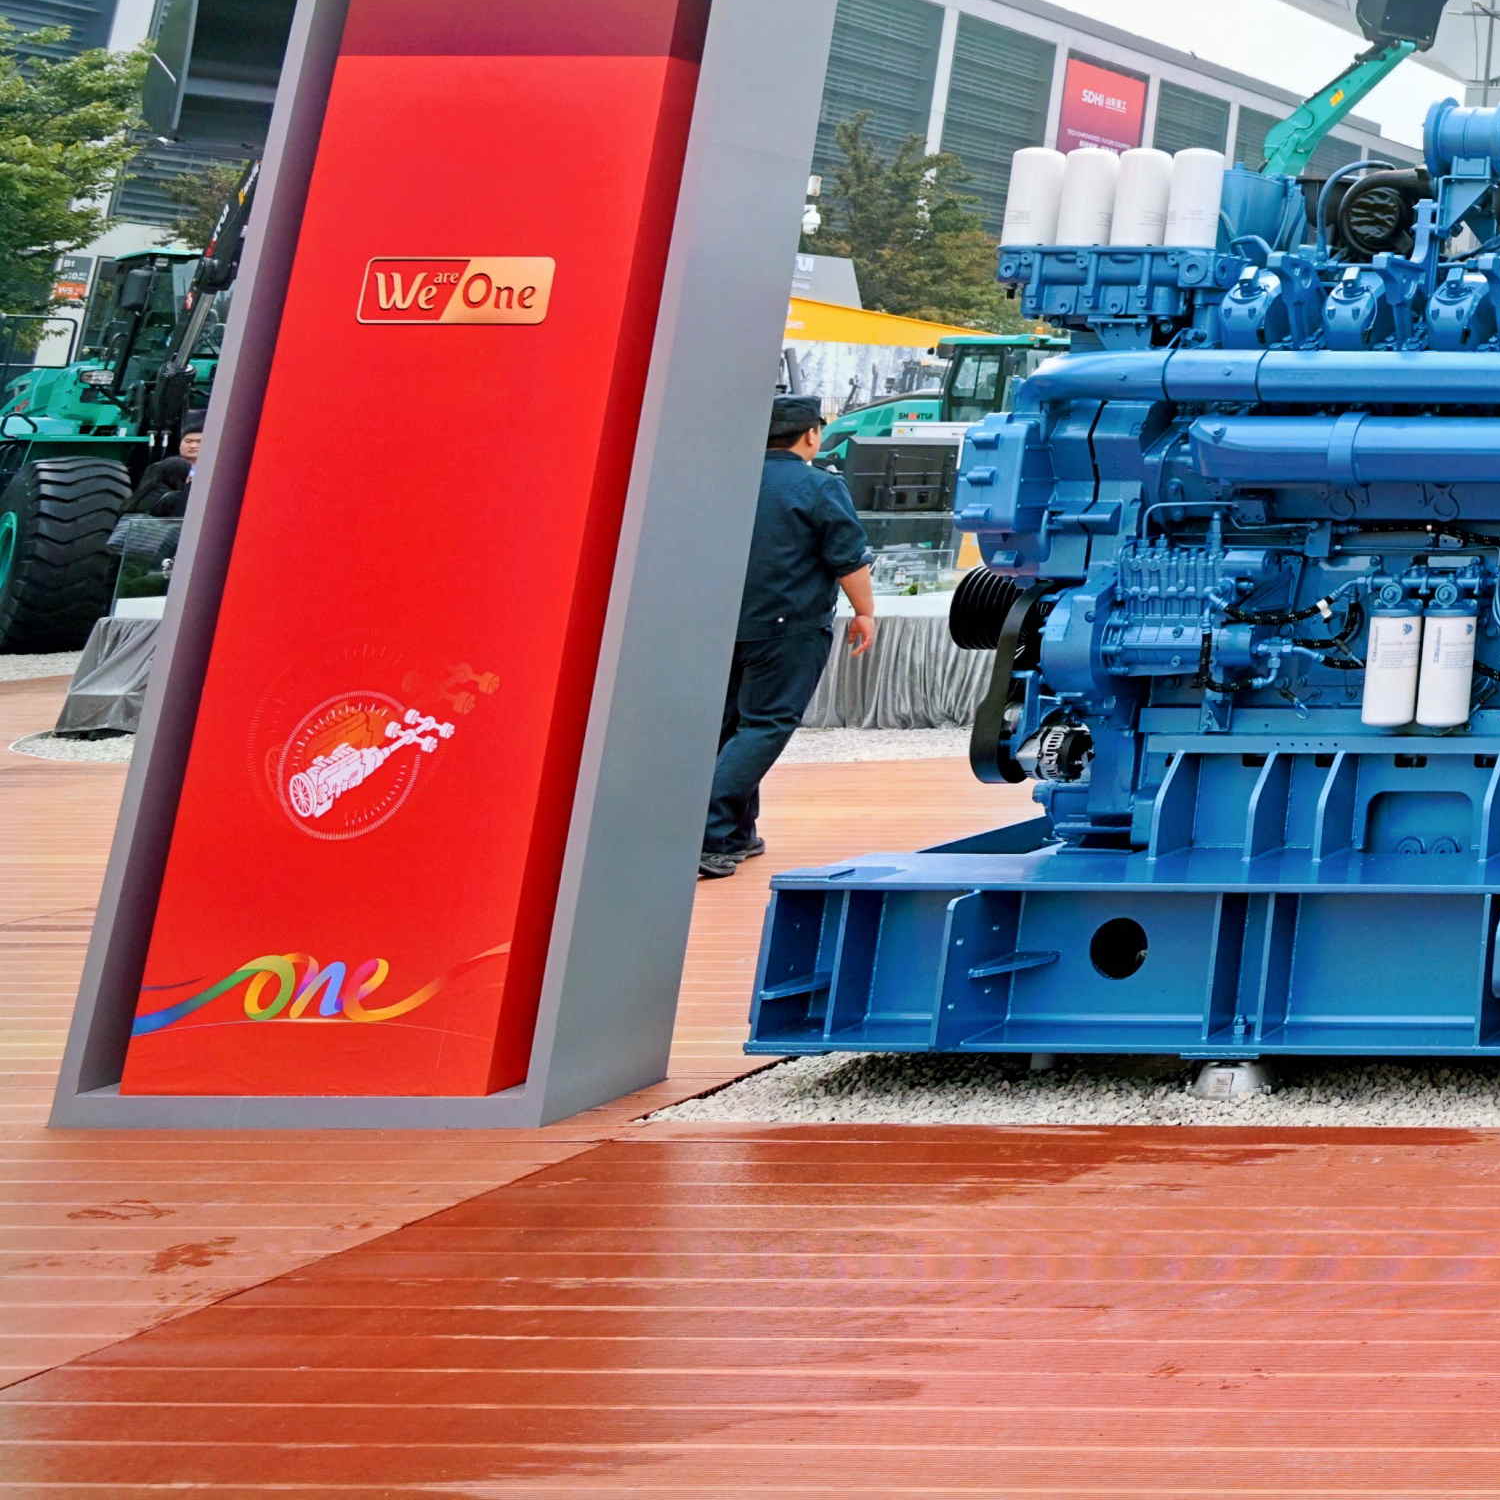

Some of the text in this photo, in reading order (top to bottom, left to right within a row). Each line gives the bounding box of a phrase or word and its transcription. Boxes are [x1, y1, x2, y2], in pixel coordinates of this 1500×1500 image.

[375, 271, 536, 310] We are One
